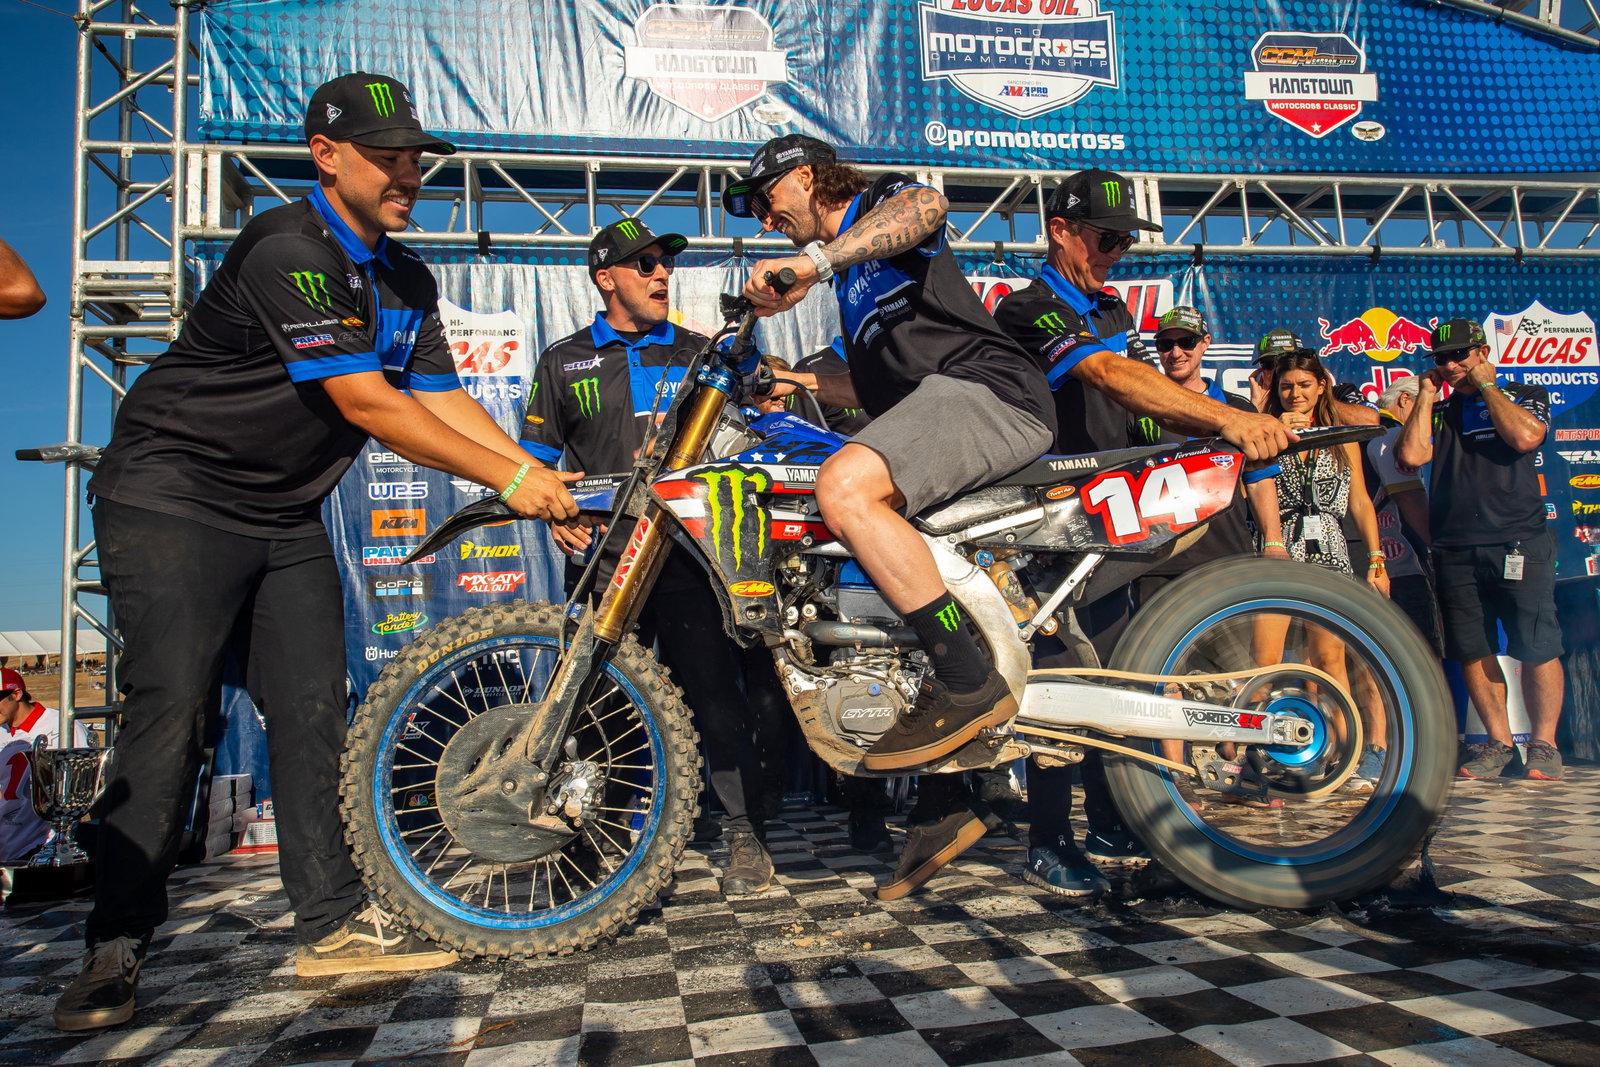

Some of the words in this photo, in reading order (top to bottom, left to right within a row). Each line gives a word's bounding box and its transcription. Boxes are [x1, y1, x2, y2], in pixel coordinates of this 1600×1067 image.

[995, 26, 1042, 36] PRO
[930, 33, 1107, 59] MOTOCROSS
[654, 53, 758, 74] HANGTOWN
[931, 52, 1109, 68] CHAMPIONSHIP
[998, 86, 1031, 97] AMA
[1030, 86, 1048, 94] PRO
[1269, 77, 1354, 95] HANGTOWN
[1271, 102, 1322, 110] MOTOCROSS
[1323, 102, 1357, 111] CLASSIC
[925, 121, 1126, 151] @promotocross
[882, 297, 909, 313] YAMAHA
[292, 334, 334, 344] PARTS
[449, 340, 520, 374] CAS
[1499, 337, 1592, 364] LUCAS
[1523, 372, 1599, 385] PRODUCTS
[375, 466, 419, 474] MOTORCYCLE
[1049, 457, 1098, 471] YAMAHA
[785, 467, 819, 482] YAMA
[584, 478, 613, 487] YAMAHA
[369, 481, 428, 499] WPS
[1087, 463, 1202, 537] 14
[379, 516, 419, 530] KTM
[363, 546, 418, 558] PAR
[474, 545, 521, 558] THOR
[375, 580, 423, 589] GoPro
[459, 574, 488, 586] MX
[493, 573, 524, 584] ATV
[469, 584, 492, 593] ALL
[492, 583, 513, 592] OUT
[730, 582, 776, 596] FMF
[386, 612, 423, 623] Battery
[377, 621, 417, 635] Tender
[415, 629, 494, 675] DUNLOP
[841, 706, 895, 719] GYTR
[1109, 697, 1172, 720] YAMALUBE
[1182, 707, 1240, 727] VORTEX
[1237, 713, 1267, 730] EK
